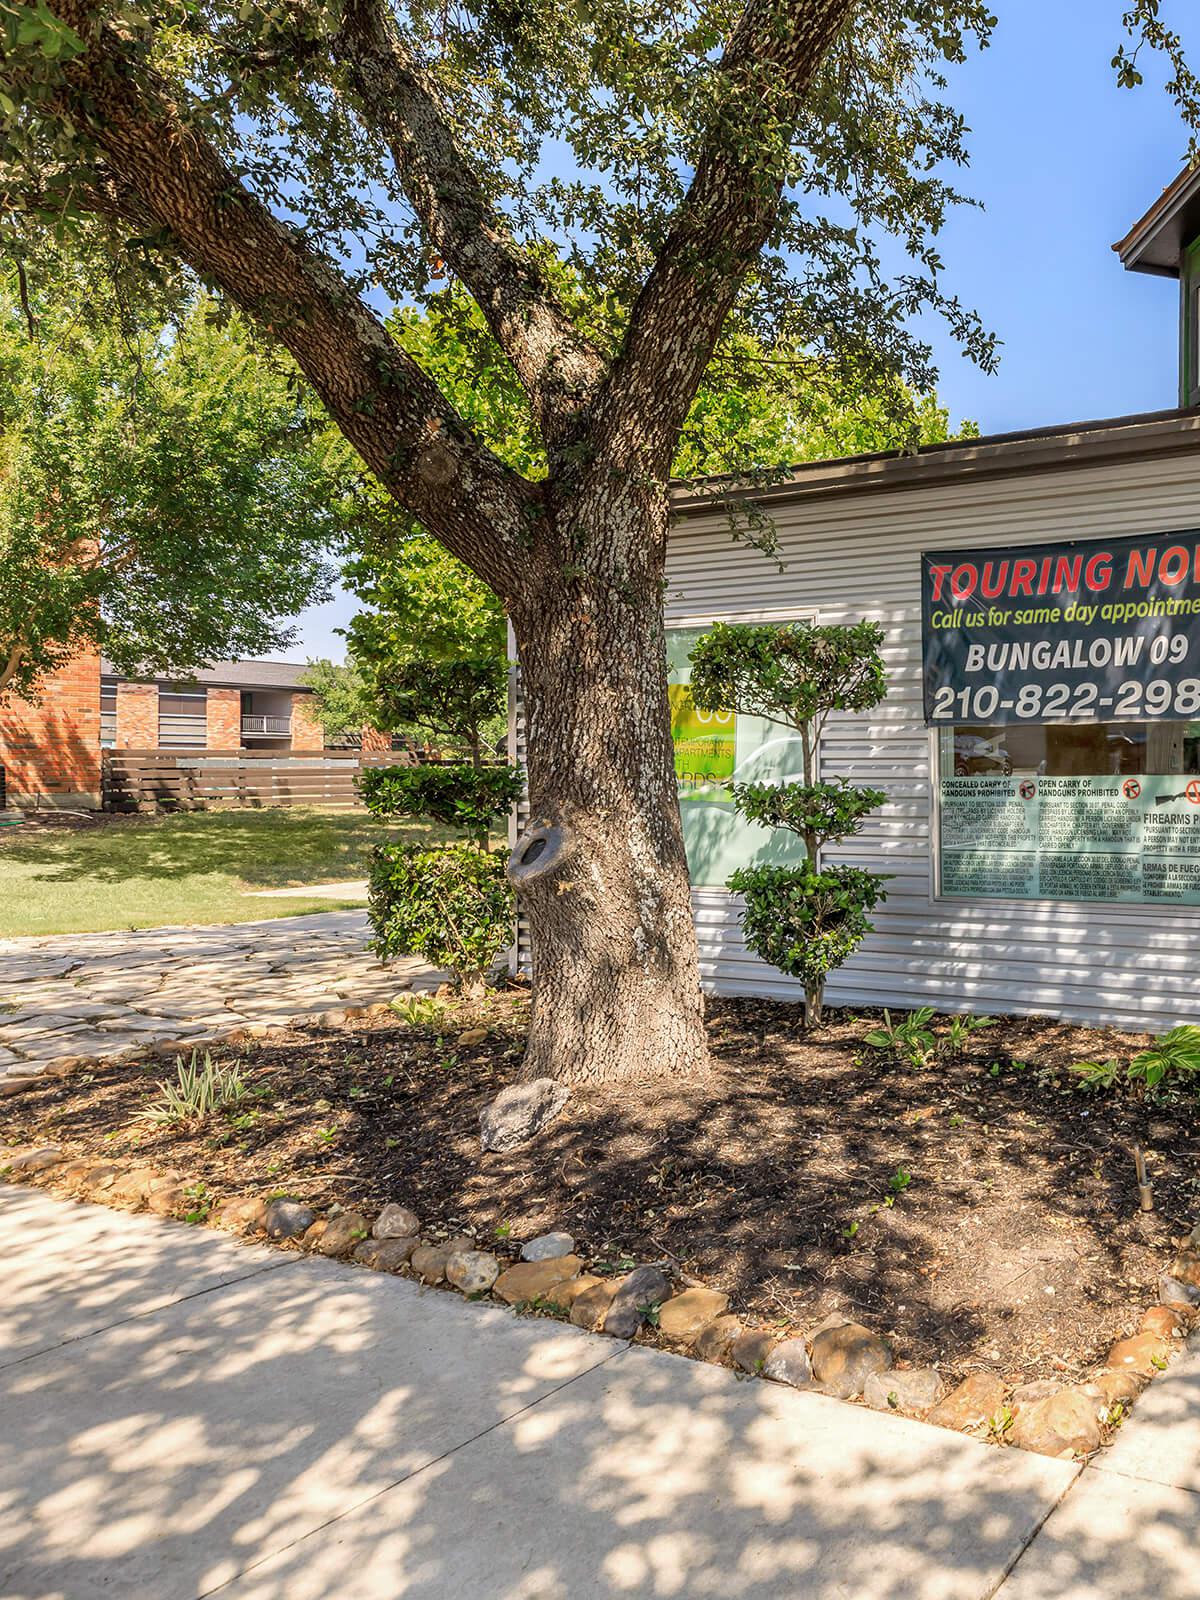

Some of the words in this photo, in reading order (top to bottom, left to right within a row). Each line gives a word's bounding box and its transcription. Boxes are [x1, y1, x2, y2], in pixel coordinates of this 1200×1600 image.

[929, 552, 1113, 601] TOURING
[931, 609, 963, 629] Call
[965, 611, 985, 627] us
[987, 607, 1010, 626] for
[1013, 608, 1061, 625] same
[1064, 602, 1099, 626] day
[965, 636, 1144, 672] BUNGALOW
[1150, 634, 1189, 665] 09
[941, 780, 979, 789] CONCEALED
[980, 780, 1001, 788] CARRY
[1003, 780, 1012, 788] OF
[941, 789, 976, 797] HANDGUNS
[977, 789, 1016, 797] PROHIBITED
[1039, 789, 1076, 797] HANDGUNS
[1078, 789, 1119, 797] PROHIBITED
[1144, 814, 1190, 824] FIREARMS
[1143, 864, 1167, 872] ARMAS
[1169, 864, 1178, 872] DE
